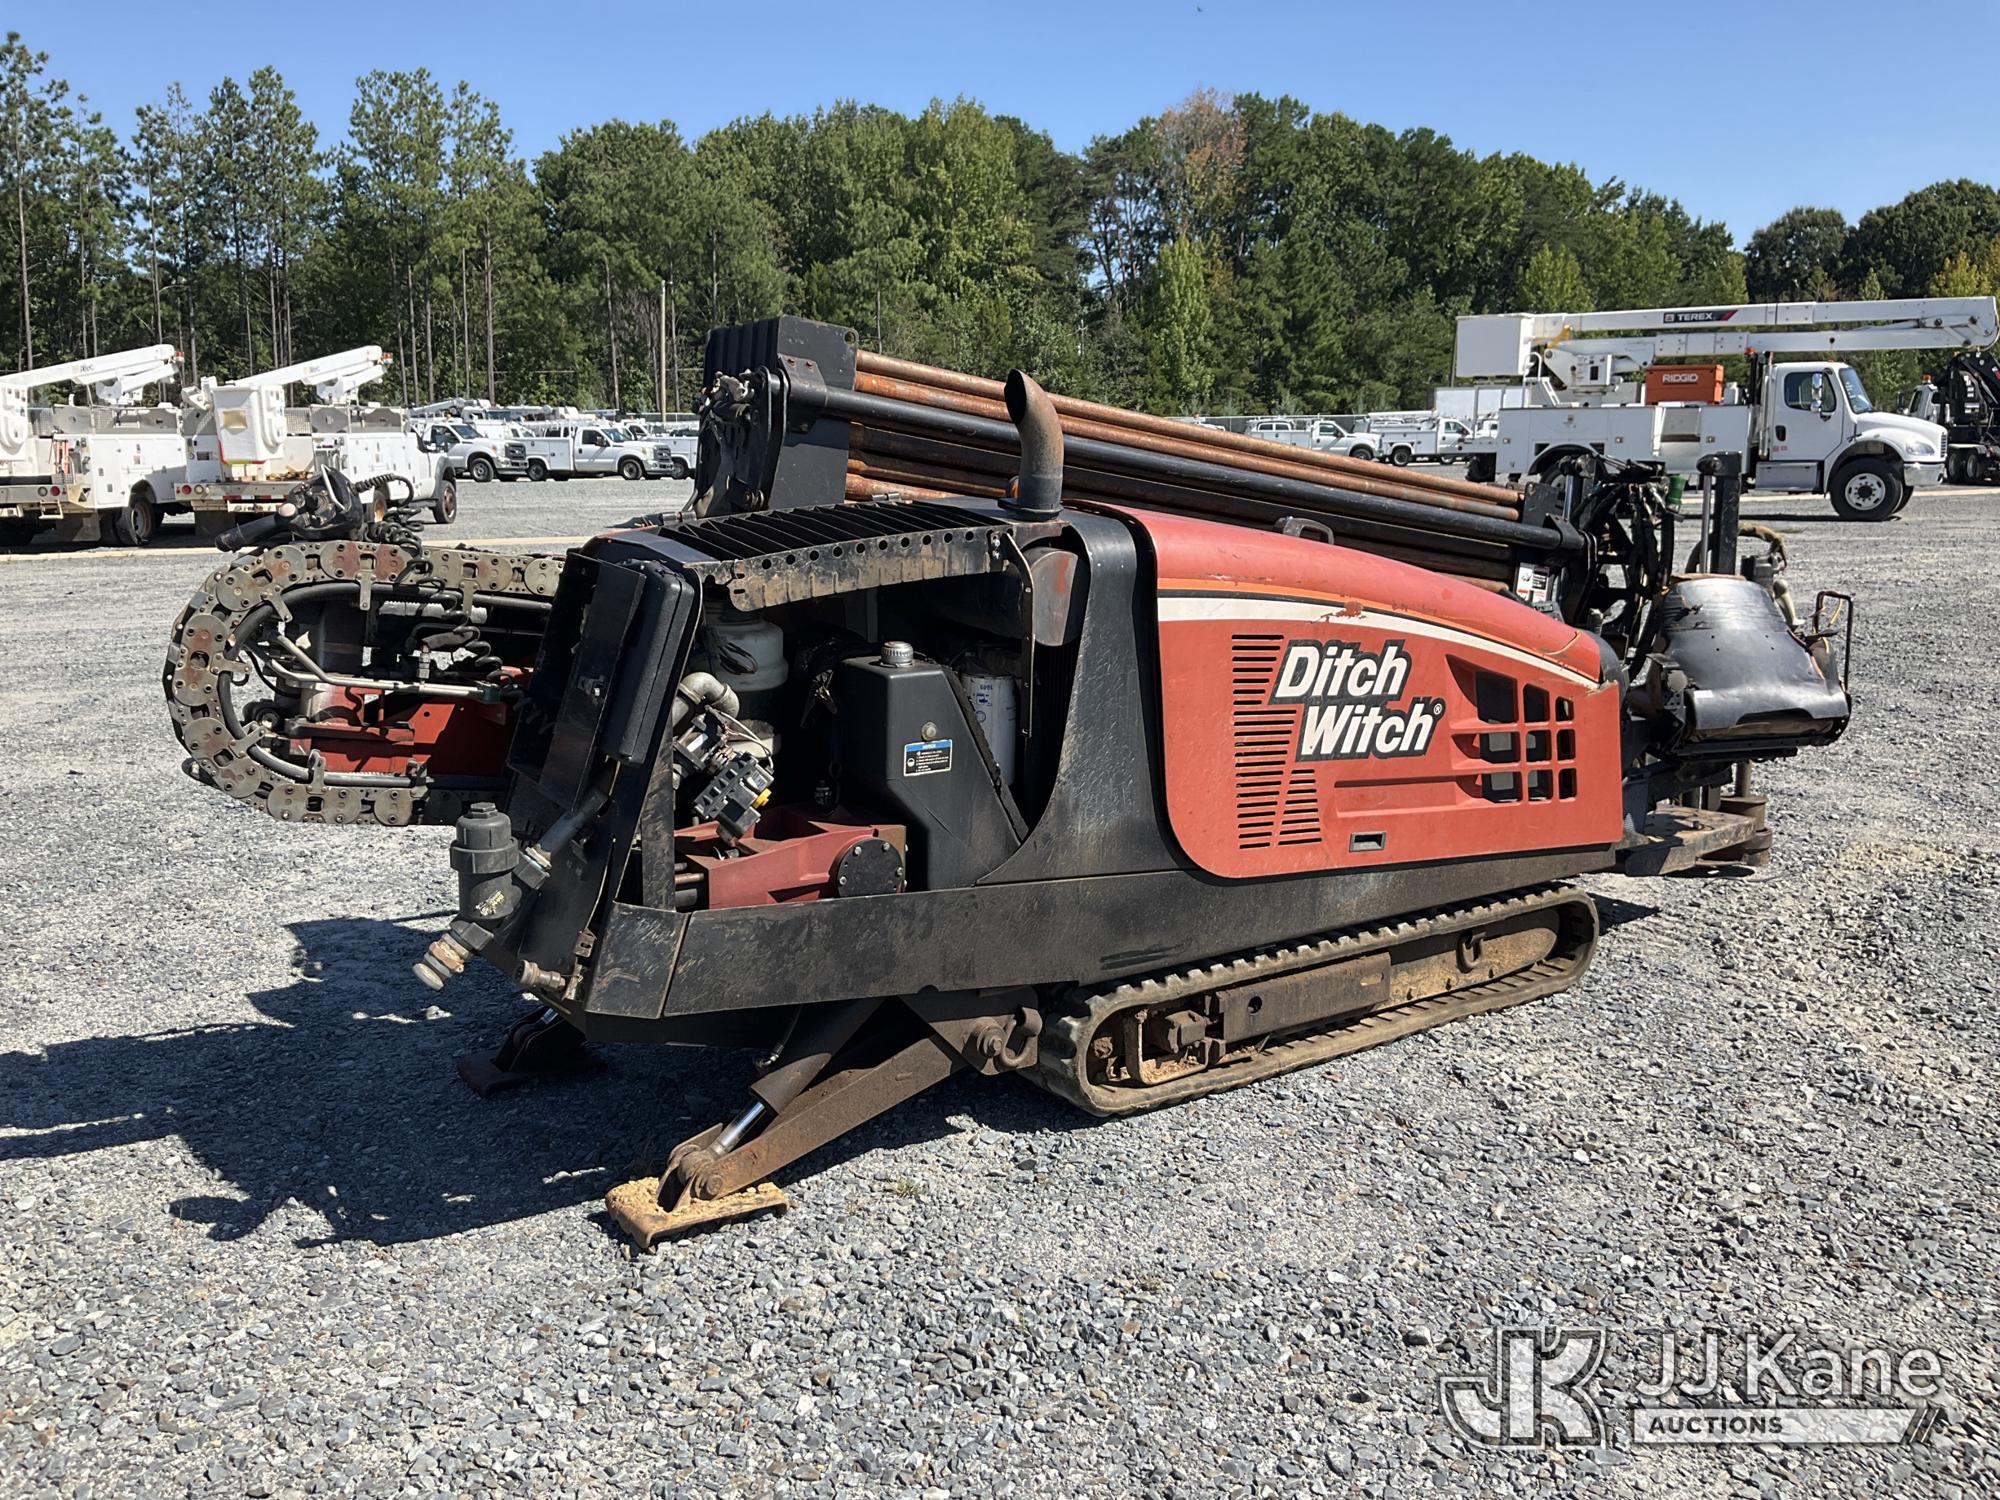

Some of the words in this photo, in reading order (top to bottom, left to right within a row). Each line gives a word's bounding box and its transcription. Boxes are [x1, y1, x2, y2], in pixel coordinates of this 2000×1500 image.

[1677, 311, 1713, 321] TEREX
[1662, 373, 1699, 384] RIDGID
[1274, 645, 1408, 698] Ditch
